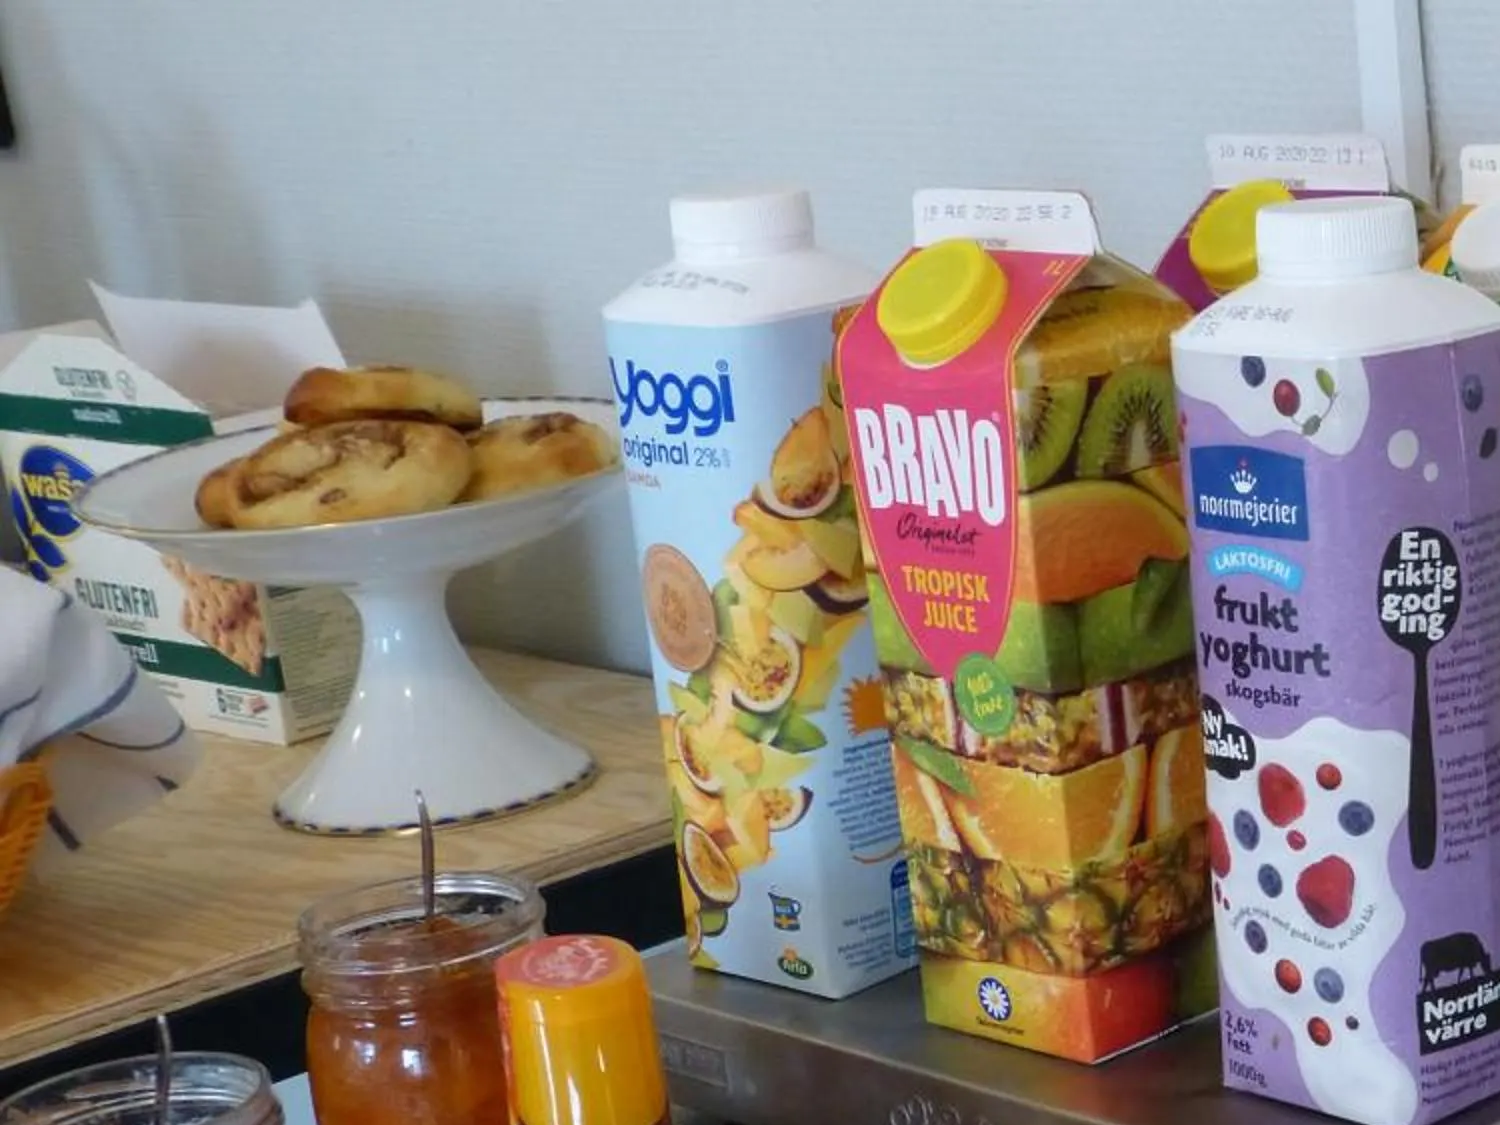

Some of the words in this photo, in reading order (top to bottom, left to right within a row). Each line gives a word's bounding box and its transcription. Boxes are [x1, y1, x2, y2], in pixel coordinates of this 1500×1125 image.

[622, 435, 689, 469] original
[855, 403, 1006, 527] BRAVO
[1199, 493, 1298, 527] norrmejerier
[1399, 530, 1441, 561] En
[900, 564, 991, 603] TROPISK
[1213, 552, 1292, 583] LAKTOSFRI
[1382, 560, 1457, 590] riktig
[75, 577, 159, 619] GLUTENFRI
[1213, 584, 1299, 633] frukt
[1381, 583, 1456, 622] god-
[923, 602, 978, 634] JUICE
[1398, 609, 1447, 642] ing
[1199, 632, 1331, 679] yoghurt
[1225, 678, 1302, 709] skogsbär
[1202, 708, 1223, 739] Ny
[1425, 1012, 1488, 1045] värre
